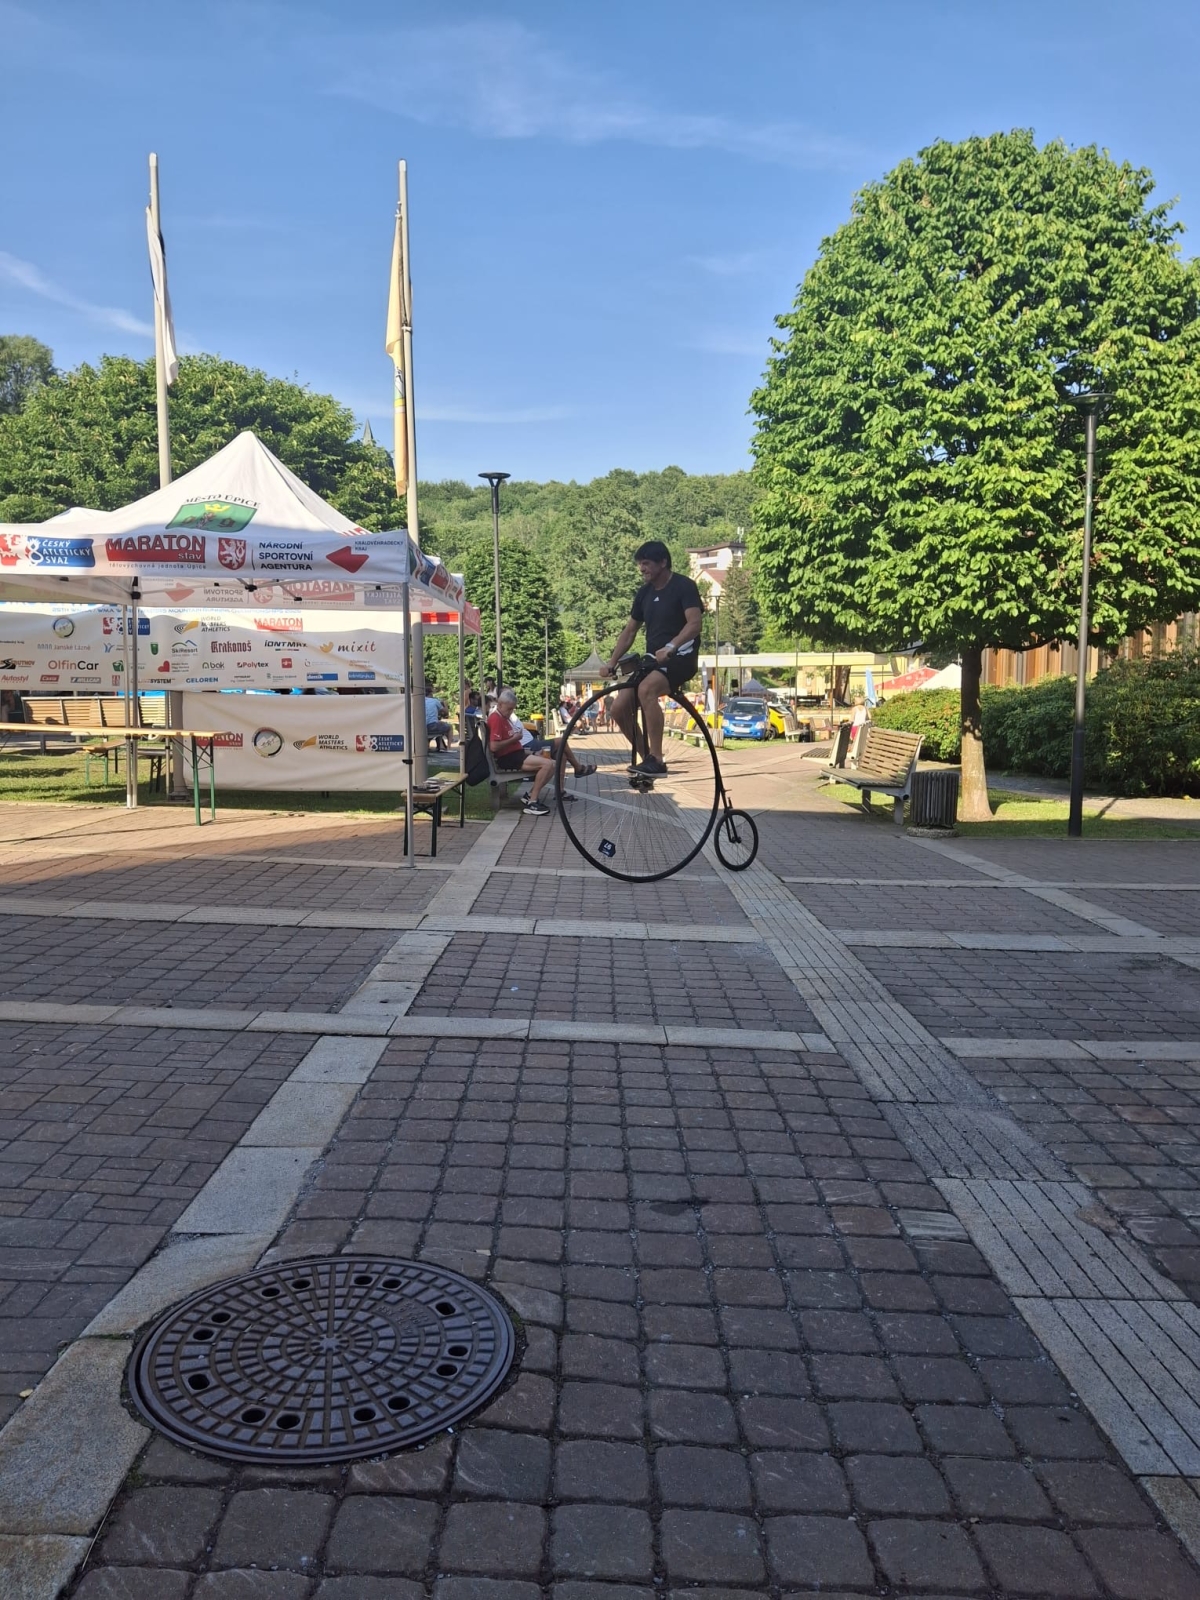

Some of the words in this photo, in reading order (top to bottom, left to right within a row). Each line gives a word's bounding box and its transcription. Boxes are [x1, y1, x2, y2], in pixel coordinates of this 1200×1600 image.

[42, 539, 71, 548] ČESKÝ
[105, 534, 206, 552] MARATON
[258, 541, 303, 550] NÁRODNÍ
[42, 547, 91, 556] ATLETICKÝ
[178, 552, 202, 560] stav
[258, 550, 314, 561] SPORTOVNÍ
[45, 556, 69, 565] SVAZ
[260, 563, 313, 571] AGENTURA
[253, 617, 303, 627] MARATON
[211, 640, 252, 653] Krakonoš
[337, 641, 377, 652] mixit
[48, 660, 99, 671] OlfinCar
[243, 661, 269, 669] Polytex
[2, 674, 29, 682] Autostyl
